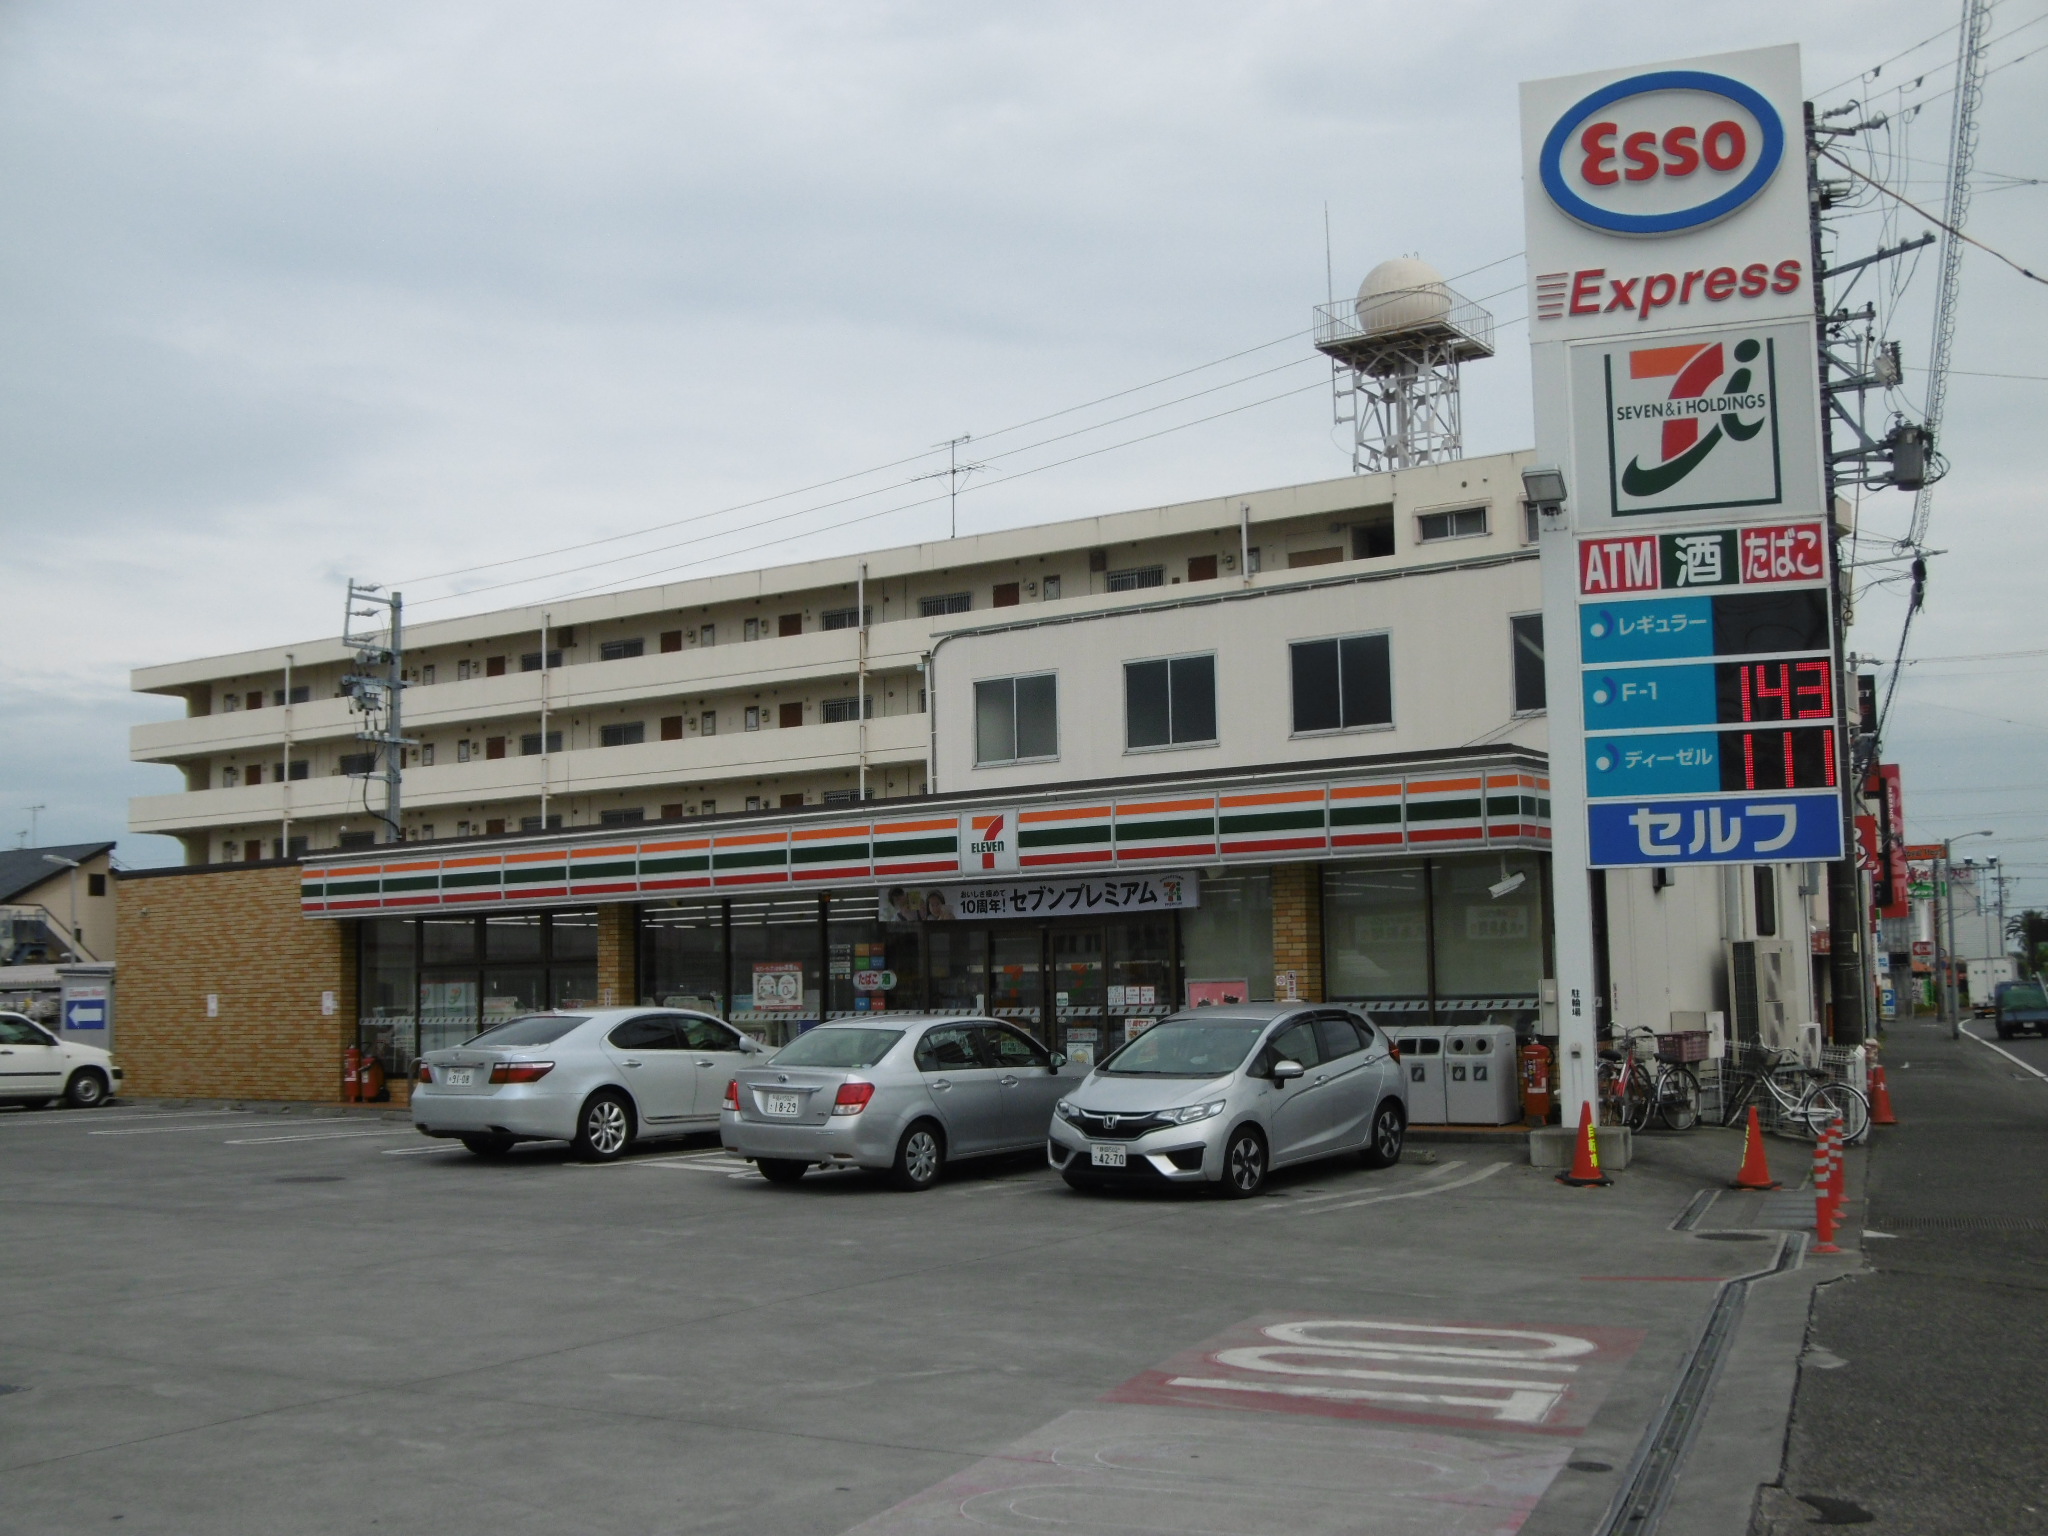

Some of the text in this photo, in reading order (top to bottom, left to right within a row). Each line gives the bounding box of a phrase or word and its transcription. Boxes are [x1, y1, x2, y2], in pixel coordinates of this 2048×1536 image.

[1568, 259, 1802, 320] Express
[1686, 394, 1766, 414] HOLDINGS
[1584, 540, 1653, 591] ATM
[1675, 534, 1723, 587] 酒
[1745, 528, 1820, 580] たばこ
[1618, 614, 1708, 636] レギュラー
[1621, 681, 1658, 702] F-1
[1740, 661, 1831, 722] 143
[1624, 748, 1714, 769] ディーゼル
[1743, 729, 1835, 790] 111
[1628, 803, 1798, 857] セルフ
[1009, 880, 1159, 913] セブンプレミアム
[858, 973, 879, 985] たばこ
[1571, 988, 1581, 1017] 駐輪場
[1882, 992, 1892, 1004] P
